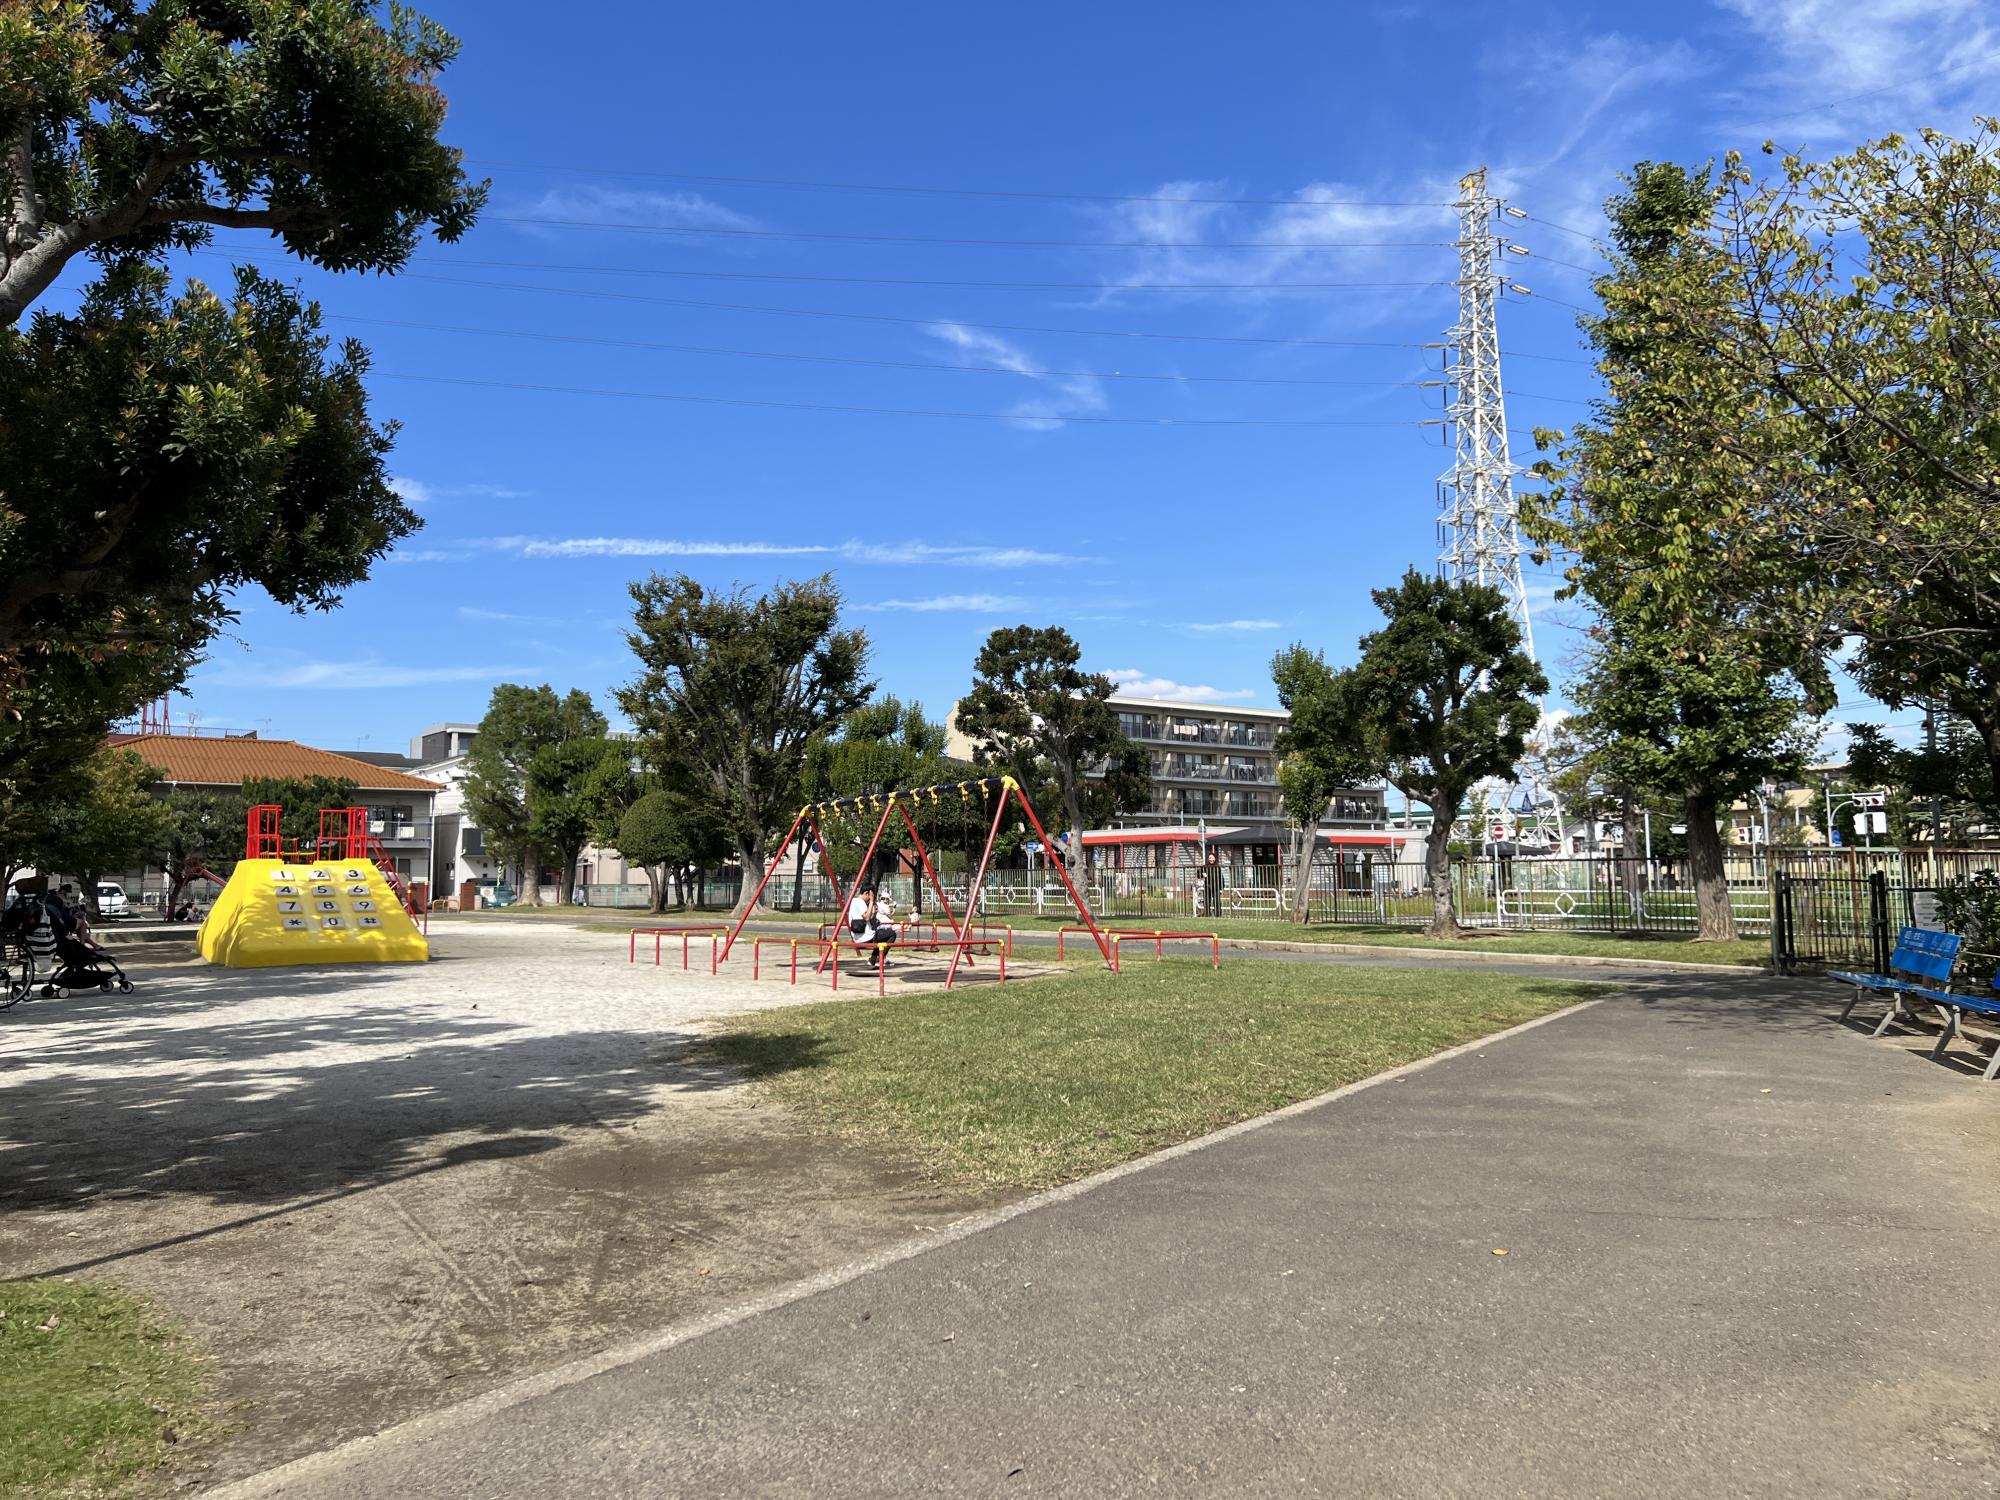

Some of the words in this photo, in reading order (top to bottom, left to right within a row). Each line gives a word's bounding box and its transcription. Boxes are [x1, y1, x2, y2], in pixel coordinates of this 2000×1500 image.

[314, 870, 325, 878] 2
[348, 869, 359, 878] 3
[280, 886, 292, 894] 4
[317, 885, 328, 894] 5
[352, 885, 364, 894] 6
[285, 901, 297, 911] 7
[323, 901, 335, 910] 8
[359, 901, 370, 910] 9
[327, 917, 339, 926] 0
